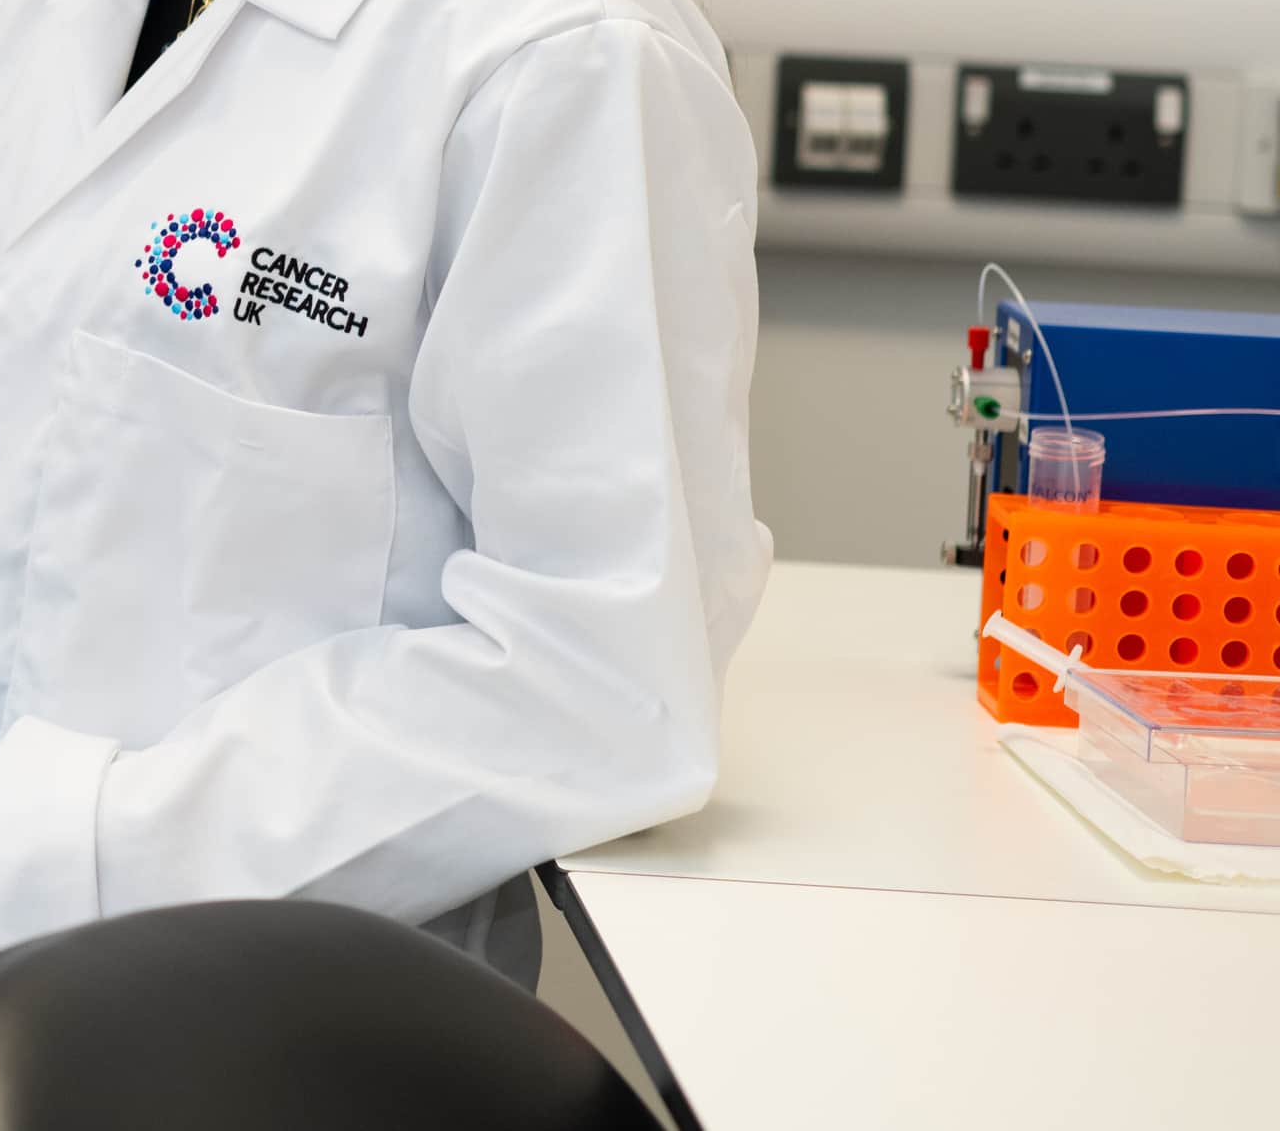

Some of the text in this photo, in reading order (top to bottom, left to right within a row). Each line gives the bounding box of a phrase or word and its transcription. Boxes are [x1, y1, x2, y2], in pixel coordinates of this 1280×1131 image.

[252, 248, 348, 302] CANCER
[234, 298, 266, 326] UK
[241, 271, 368, 337] RESEARCH
